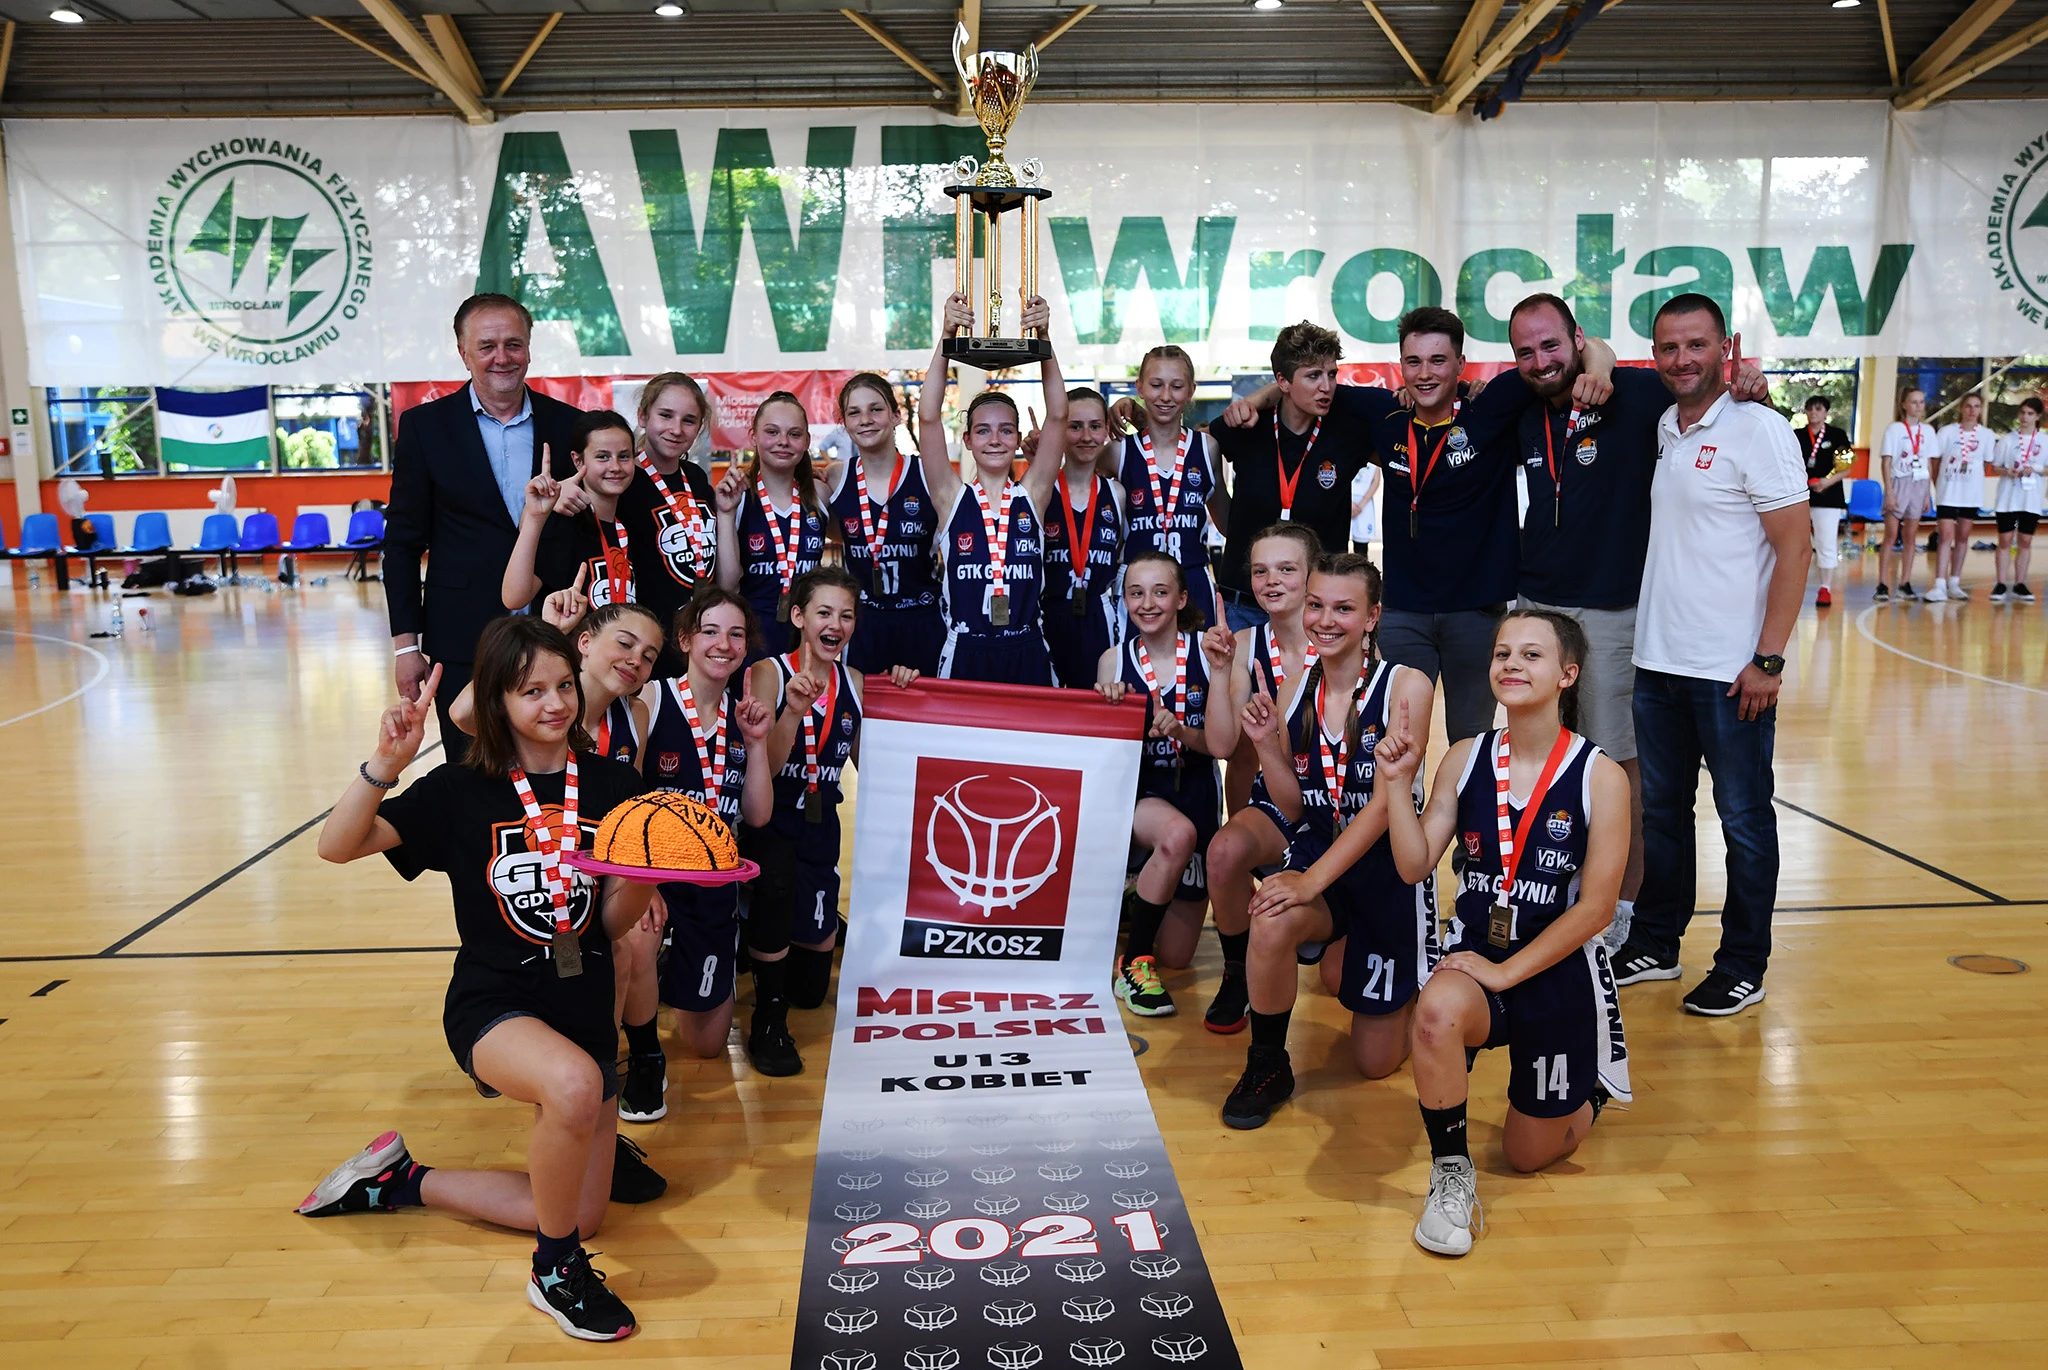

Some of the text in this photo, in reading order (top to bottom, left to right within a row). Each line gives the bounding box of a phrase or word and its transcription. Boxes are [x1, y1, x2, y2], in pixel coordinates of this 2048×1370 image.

[148, 138, 373, 320] AKADEMIA WYCHOWANIA FIZYCZNEGO
[1988, 173, 2018, 291] AKADEMIA
[1049, 214, 1914, 345] Wrocław
[209, 301, 284, 310] WROCŁAW
[2016, 298, 2042, 324] WE
[193, 325, 340, 365] WE WROCŁAWIU
[1448, 448, 1471, 467] VBW
[1185, 493, 1203, 505] VBW
[902, 522, 922, 534] VBW
[1131, 516, 1154, 531] GTK
[1015, 540, 1036, 552] VBW
[749, 561, 775, 575] GTK
[957, 564, 982, 579] GTK
[1357, 763, 1376, 779] VB
[1548, 819, 1572, 831] GTK
[1538, 849, 1569, 869] VBW
[1467, 871, 1490, 892] GTK
[814, 890, 825, 929] 4
[699, 955, 718, 997] 8
[1363, 953, 1395, 1001] 21
[857, 987, 1099, 1017] MISTRZ
[1594, 945, 1627, 1063] GDYNIA
[853, 1017, 1106, 1043] POLSKI
[934, 1052, 1031, 1068] U13
[881, 1070, 1092, 1093] KOBIET
[1533, 1054, 1569, 1100] 14
[841, 1210, 1164, 1266] 2021
